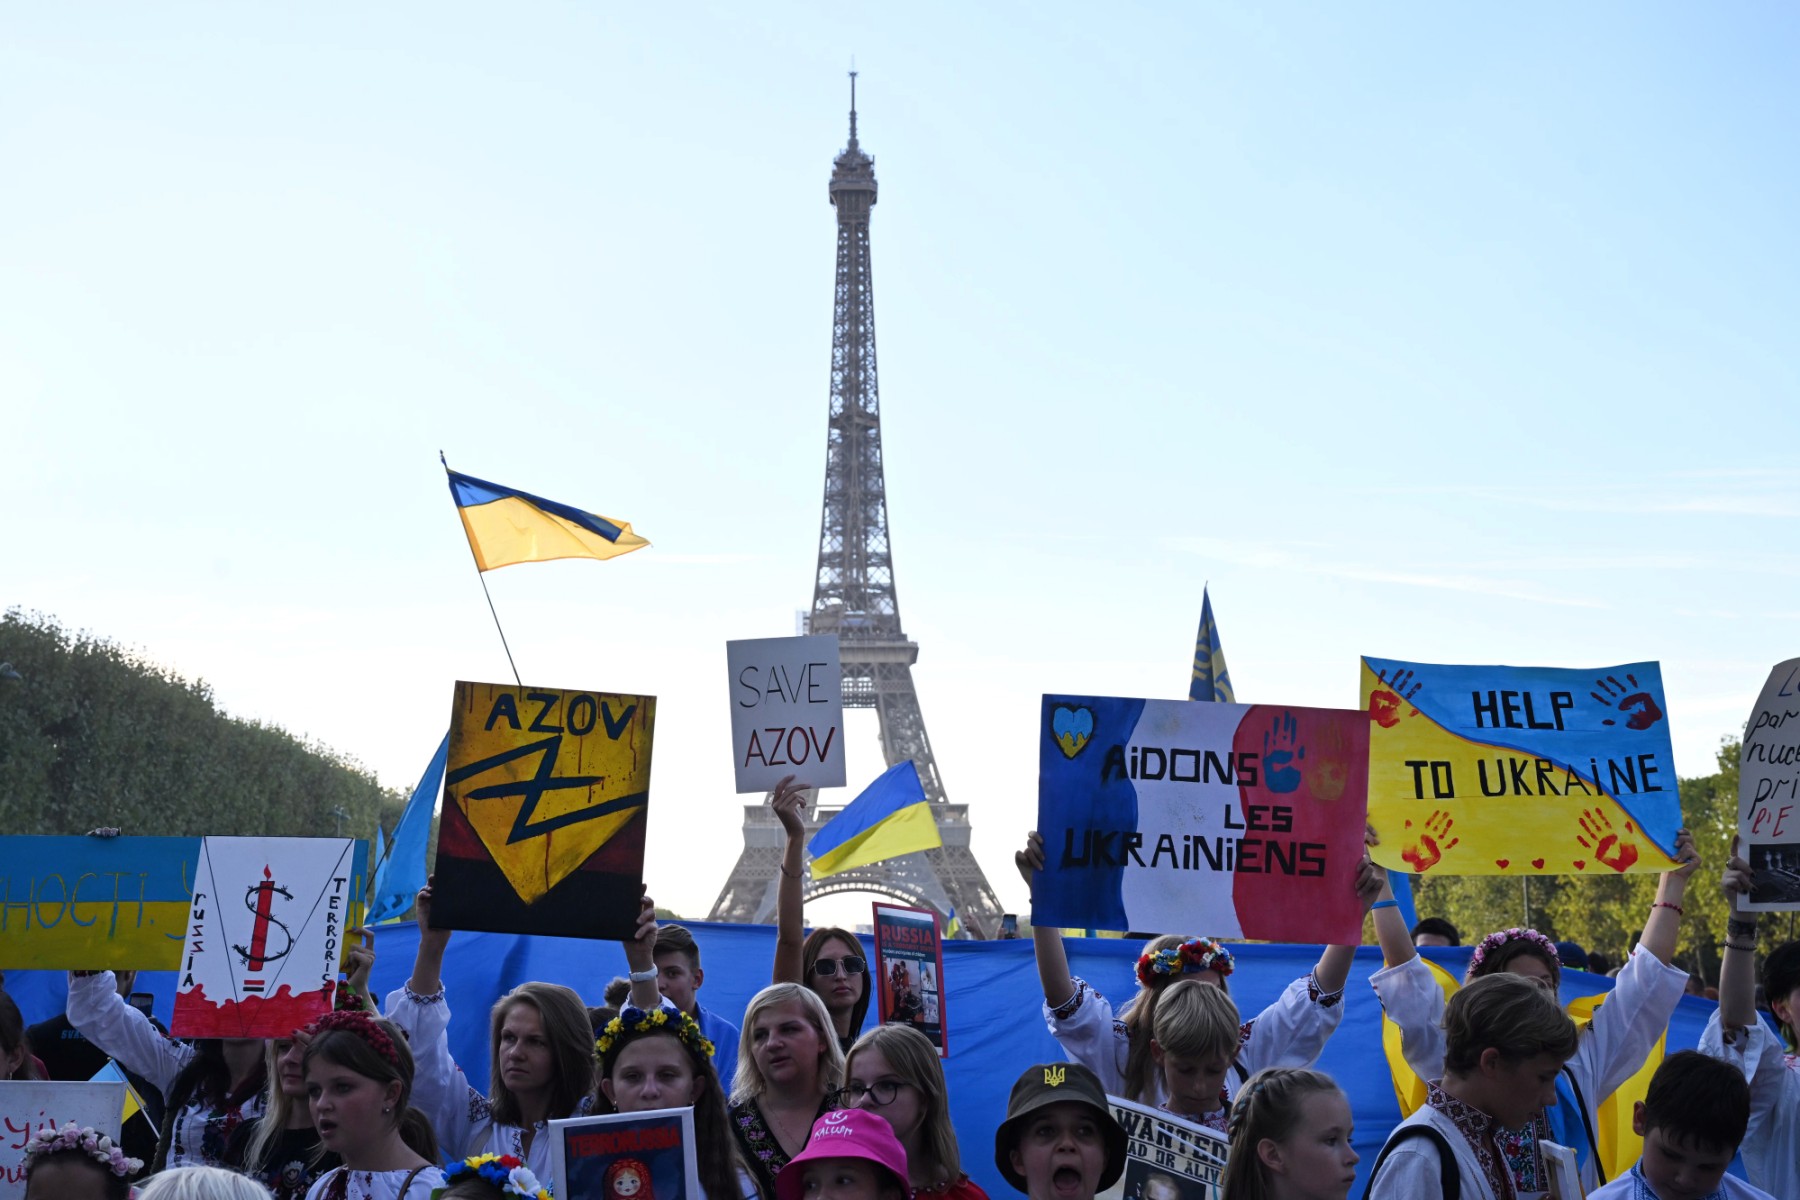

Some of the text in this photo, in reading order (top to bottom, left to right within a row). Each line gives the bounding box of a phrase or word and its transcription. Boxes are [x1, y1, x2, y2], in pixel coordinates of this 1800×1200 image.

[738, 662, 829, 708] SAVE
[1778, 666, 1800, 697] L
[484, 693, 637, 740] AZOV
[1471, 690, 1574, 731] HELP
[744, 725, 836, 768] AZOV
[1404, 760, 1455, 799] TO
[1224, 804, 1293, 832] LES
[881, 924, 934, 946] RUSSIA
[1116, 1108, 1227, 1165] WANTED
